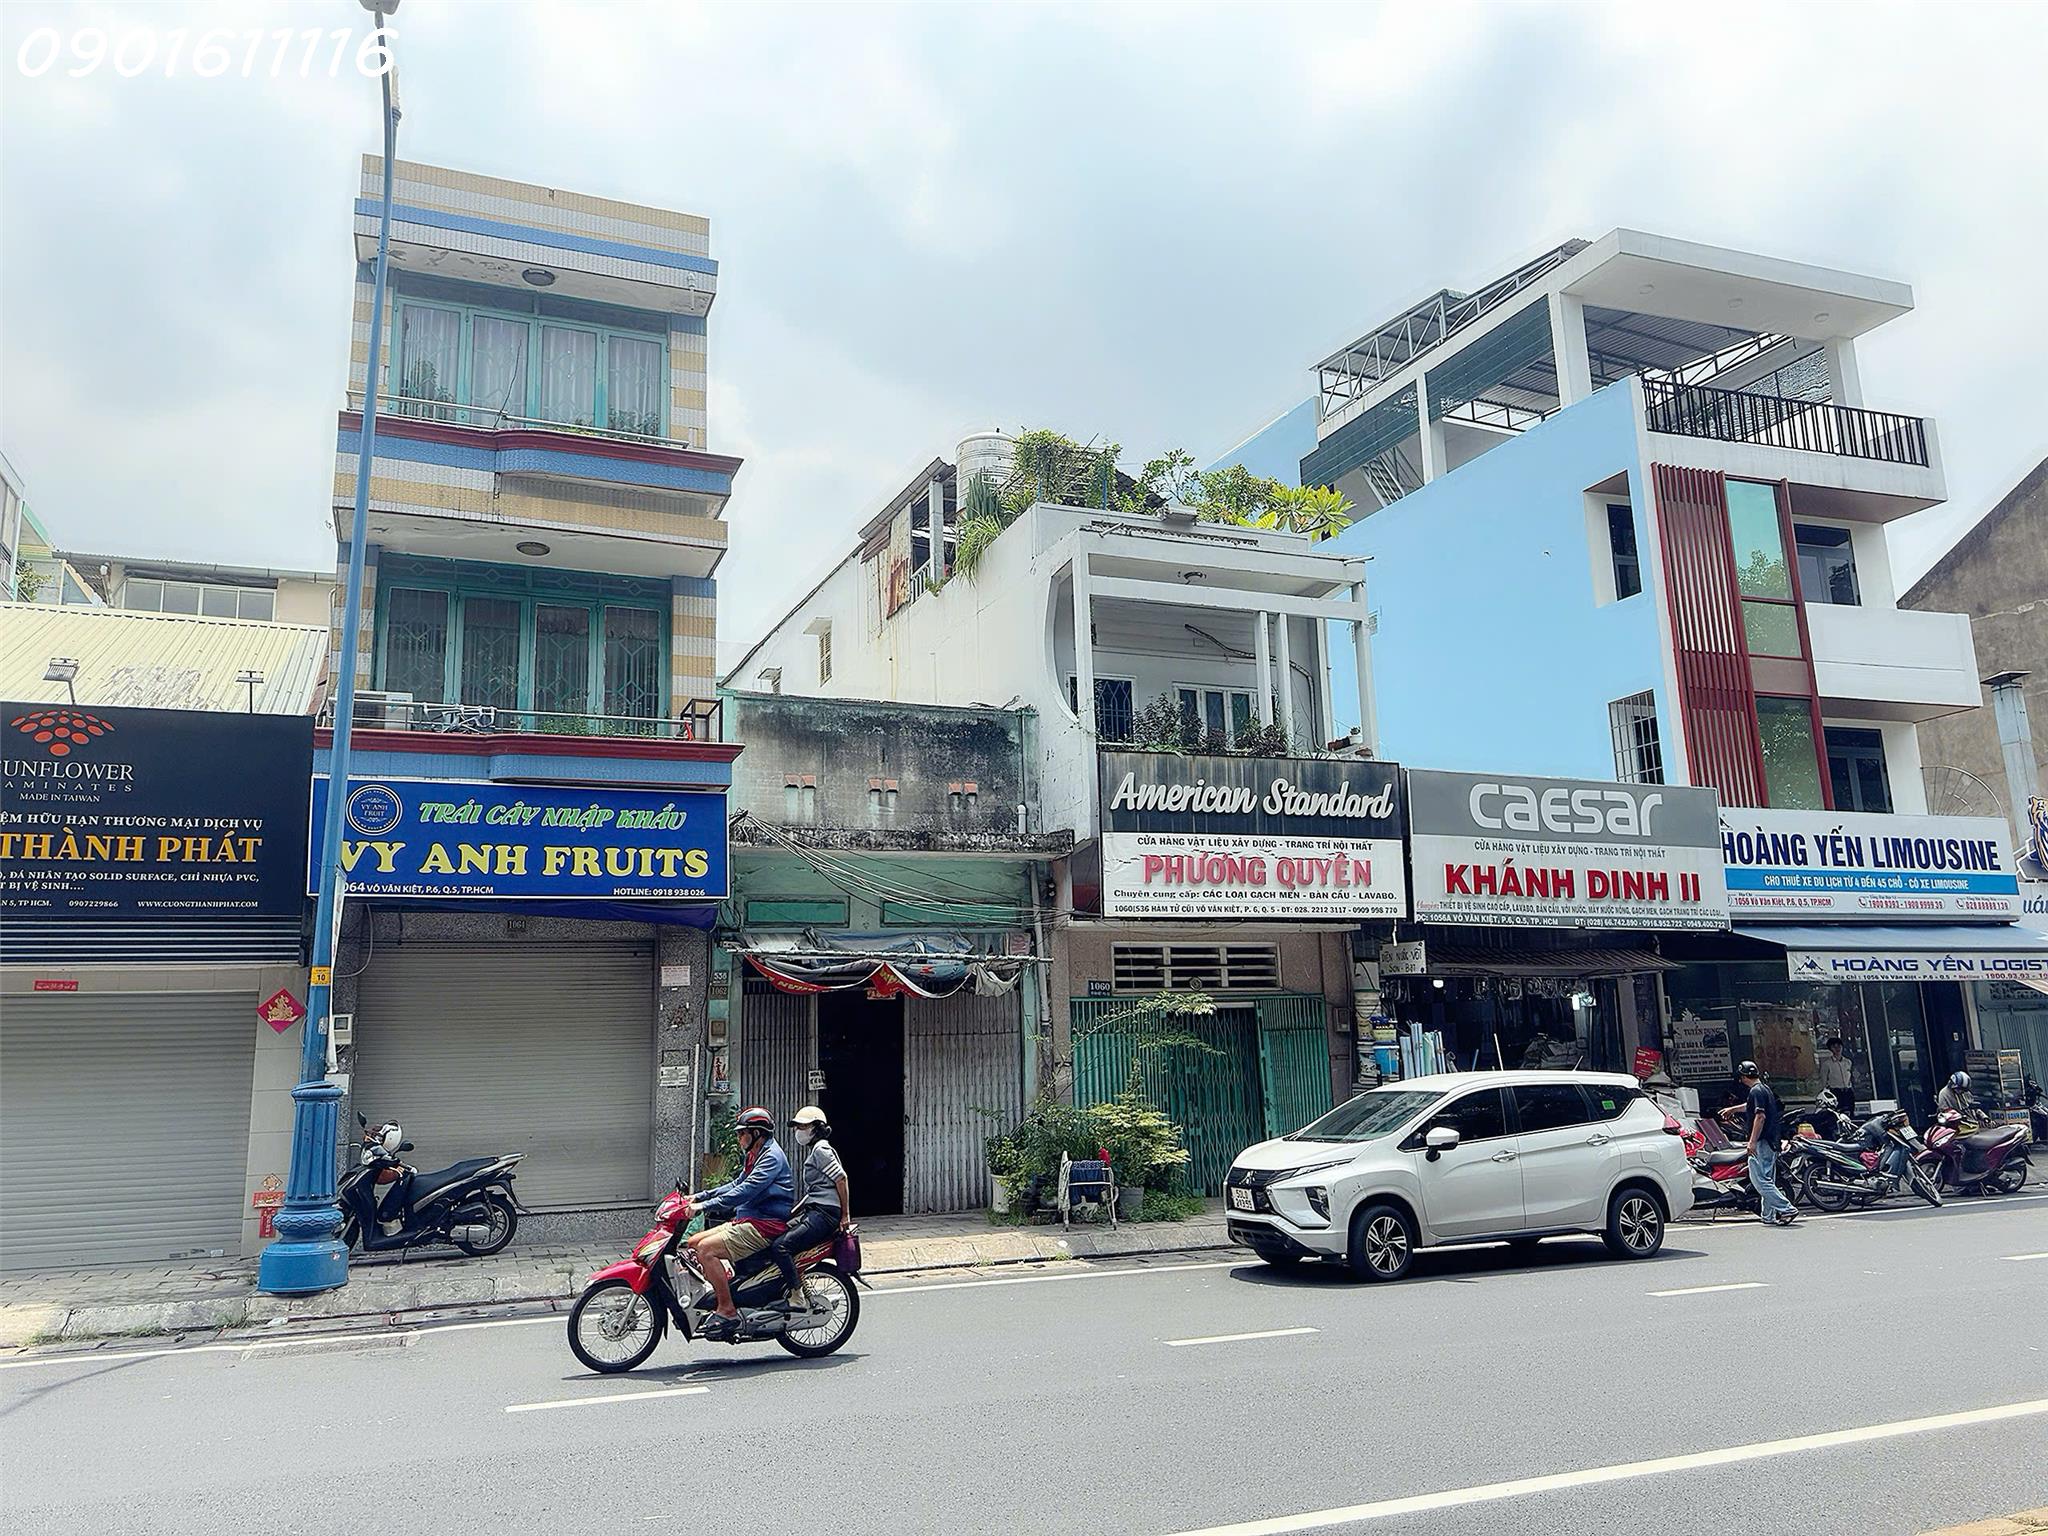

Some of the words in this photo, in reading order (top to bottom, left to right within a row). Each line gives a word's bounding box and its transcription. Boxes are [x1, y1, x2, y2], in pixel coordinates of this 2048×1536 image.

[0, 760, 134, 780] UNFLOWER
[63, 794, 100, 802] TAIWAN
[1110, 772, 1258, 813] American
[1263, 778, 1394, 819] Standard
[27, 812, 61, 824] HỮU
[66, 815, 99, 827] HẠN
[103, 815, 166, 828] THƯƠNG
[170, 817, 200, 828] MẠI
[203, 818, 239, 829] DỊCH
[243, 819, 263, 831] VỤ
[419, 799, 483, 824] TRÁI
[485, 801, 541, 826] CÂY
[541, 804, 615, 832] NHẬP
[616, 803, 687, 830] KHẨU
[0, 827, 146, 862] THÀNH
[156, 830, 263, 863] PHÁT
[1137, 835, 1156, 845] CỬA
[1160, 836, 1185, 846] HÀNG
[1187, 836, 1205, 847] VẬT
[1208, 837, 1229, 848] LIỆU
[1232, 837, 1249, 847] XÂY
[1285, 840, 1314, 848] TRANG
[1316, 840, 1331, 849] TRÍ
[1333, 840, 1348, 850] NỘI
[1350, 840, 1373, 850] THẤT
[1474, 839, 1491, 851] CỬA
[1492, 840, 1514, 852] HÀNG
[1516, 842, 1531, 855] VẬT
[1533, 843, 1550, 856] LIỆU
[1551, 844, 1566, 855] XÂY
[1568, 845, 1588, 857] DỰNG
[1595, 847, 1618, 857] TRANG
[1620, 846, 1632, 856] TRÍ
[1633, 847, 1646, 859] NỘI
[1647, 846, 1666, 858] THẤT
[1721, 825, 1808, 866] HOÀNG
[1813, 825, 1865, 868] YẾN
[1872, 836, 2001, 871] LIMOUSINE
[342, 841, 406, 873] VY
[419, 843, 528, 875] ANH
[542, 846, 709, 878] FRUITS
[10, 869, 24, 879] ĐÁ
[65, 872, 86, 882] TẠO
[89, 872, 123, 880] SOLID
[125, 873, 178, 882] SURFACE,
[203, 873, 233, 883] NHỰA
[236, 874, 260, 883] PVC,
[1144, 851, 1266, 885] PHƯƠNG
[1276, 852, 1373, 891] QUYÊN
[9, 882, 21, 891] BỊ
[24, 881, 39, 891] VỆ
[1445, 857, 1576, 899] KHÁNH
[1586, 868, 1670, 902] DINH
[1679, 872, 1702, 903] II
[1764, 875, 1780, 886] CHO
[1781, 874, 1800, 887] THUÊ
[1802, 876, 1812, 887] XE
[1813, 876, 1824, 887] DU
[1825, 877, 1842, 889] LỊCH
[1843, 875, 1854, 887] TỪ
[1855, 878, 1860, 887] 4
[1862, 875, 1875, 888] ĐẾN
[1877, 878, 1887, 888] 45
[1909, 877, 1919, 889] CÓ
[1920, 878, 1931, 889] XE
[1932, 879, 1969, 890] LIMOUSINE
[382, 884, 400, 893] VĂN
[403, 884, 424, 895] KIỆT,
[426, 886, 441, 894] P.6,
[443, 886, 460, 895] Q.5,
[461, 886, 494, 894] TP.HCM
[1113, 889, 1149, 898] Chuyên
[1203, 889, 1222, 898] CÁC
[1225, 890, 1247, 899] LOẠI
[1250, 891, 1276, 900] GẠCH
[1224, 905, 1243, 914] KIỆT,
[1473, 902, 1486, 910] SINH
[1487, 902, 1498, 910] CAO
[1832, 956, 1918, 971] HOÀNG
[1091, 982, 1110, 990] 1060
